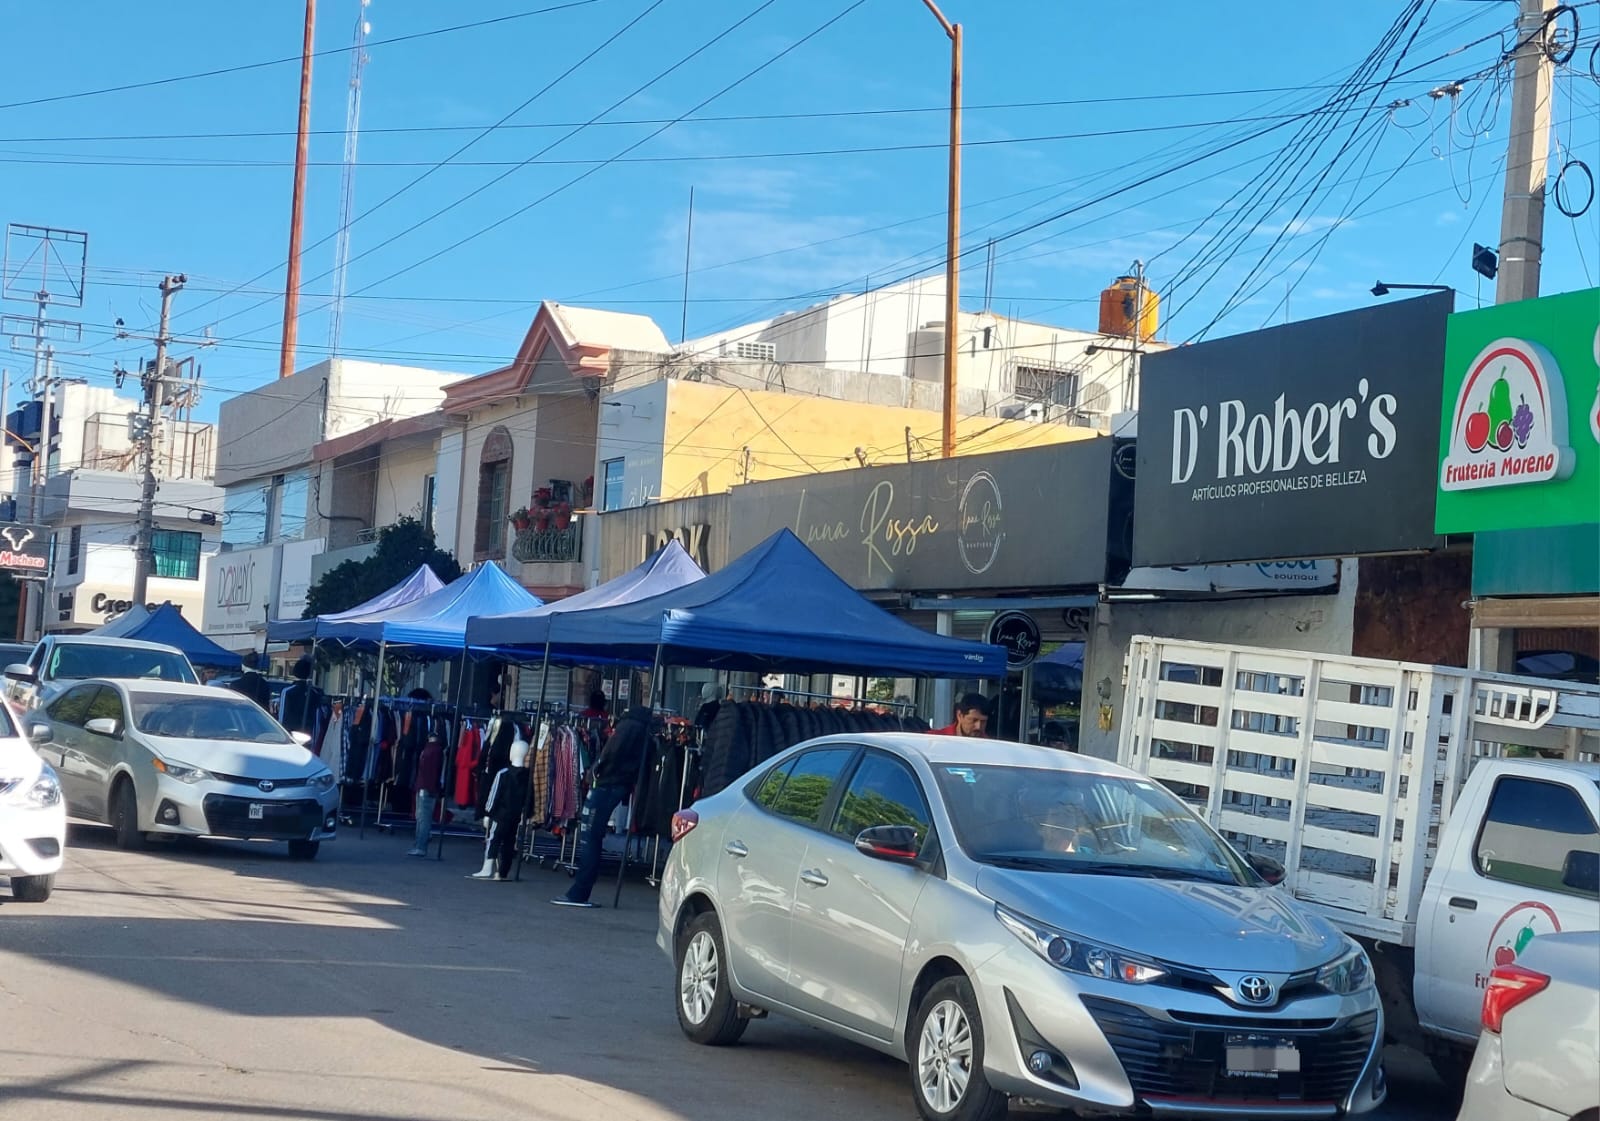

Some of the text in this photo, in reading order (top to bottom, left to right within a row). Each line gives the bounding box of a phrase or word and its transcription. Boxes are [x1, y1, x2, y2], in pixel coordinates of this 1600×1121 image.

[1217, 378, 1397, 479] Rober's
[1446, 453, 1555, 484] Fruteria Moreno
[1191, 469, 1368, 501] ARTÍCULOS PROFESIONALES DE BELLEZA
[793, 480, 939, 579] Luna Rossa
[1245, 559, 1318, 578] ossa
[1274, 573, 1320, 582] BOUTIQUE
